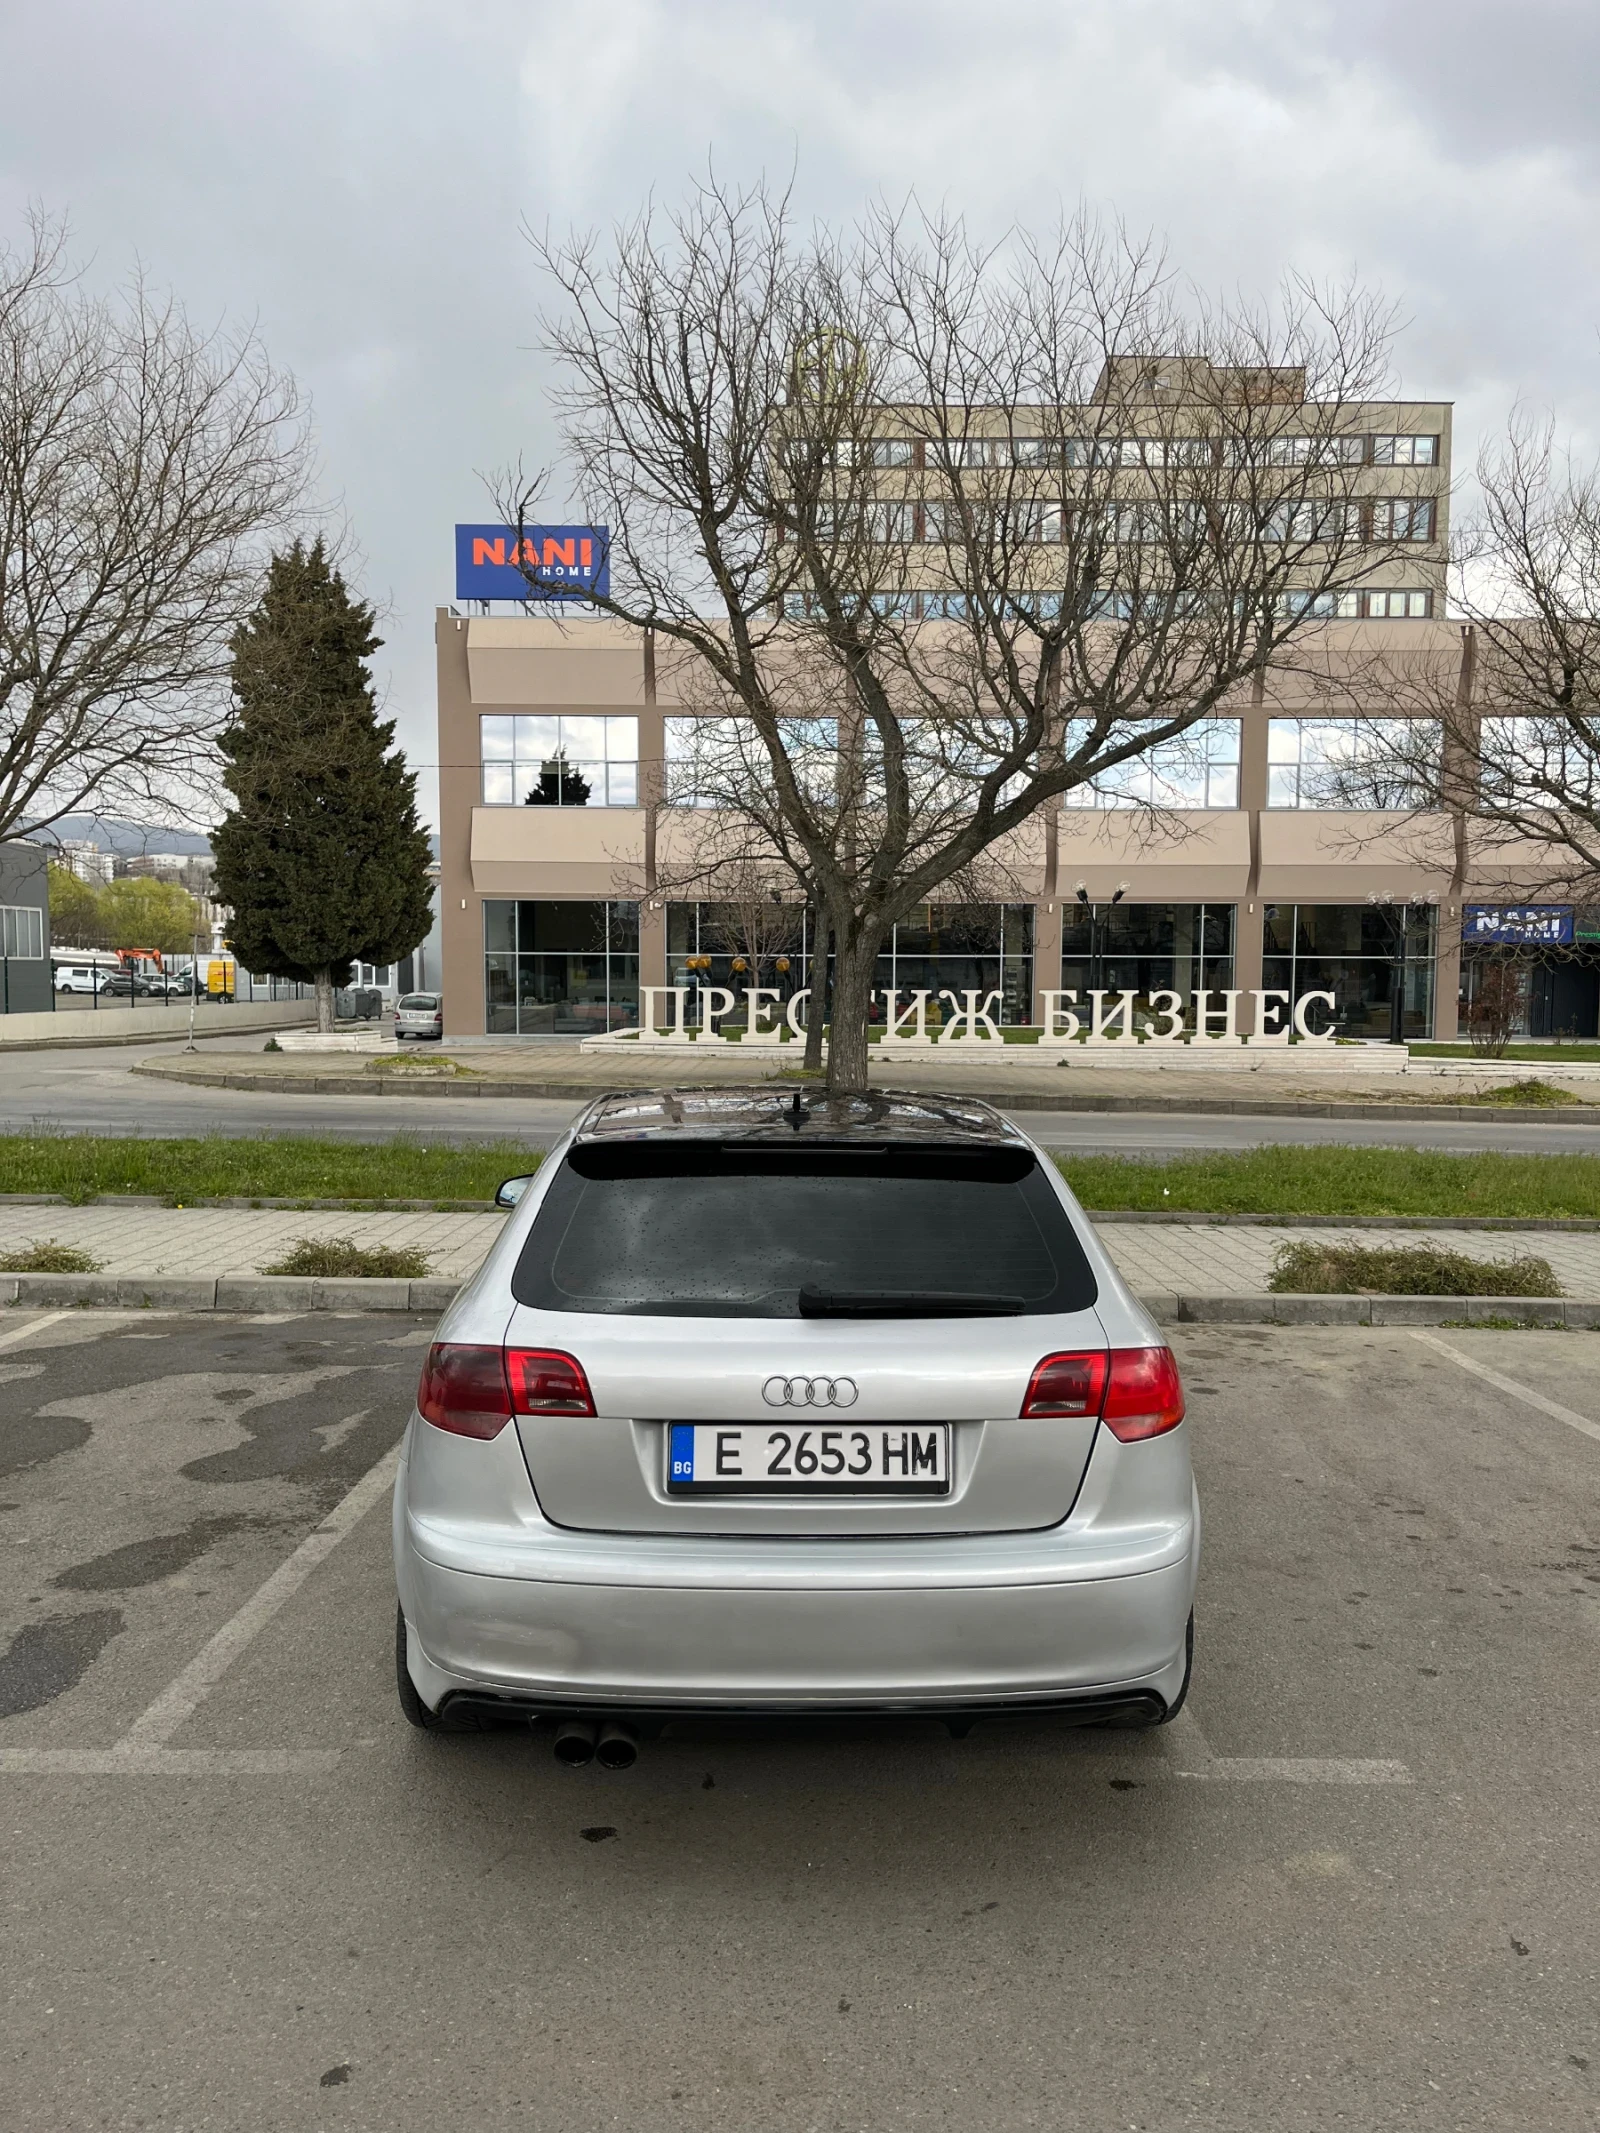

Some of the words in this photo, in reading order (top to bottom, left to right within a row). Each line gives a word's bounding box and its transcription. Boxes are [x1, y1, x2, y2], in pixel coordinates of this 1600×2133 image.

[473, 538, 592, 566] NANI
[542, 566, 592, 576] HOME
[639, 986, 1004, 1042] ПРЕСИЖ
[1038, 990, 1336, 1043] БИЗНЕС
[673, 1461, 692, 1474] BG
[716, 1432, 742, 1475] E
[767, 1432, 872, 1475] 2653
